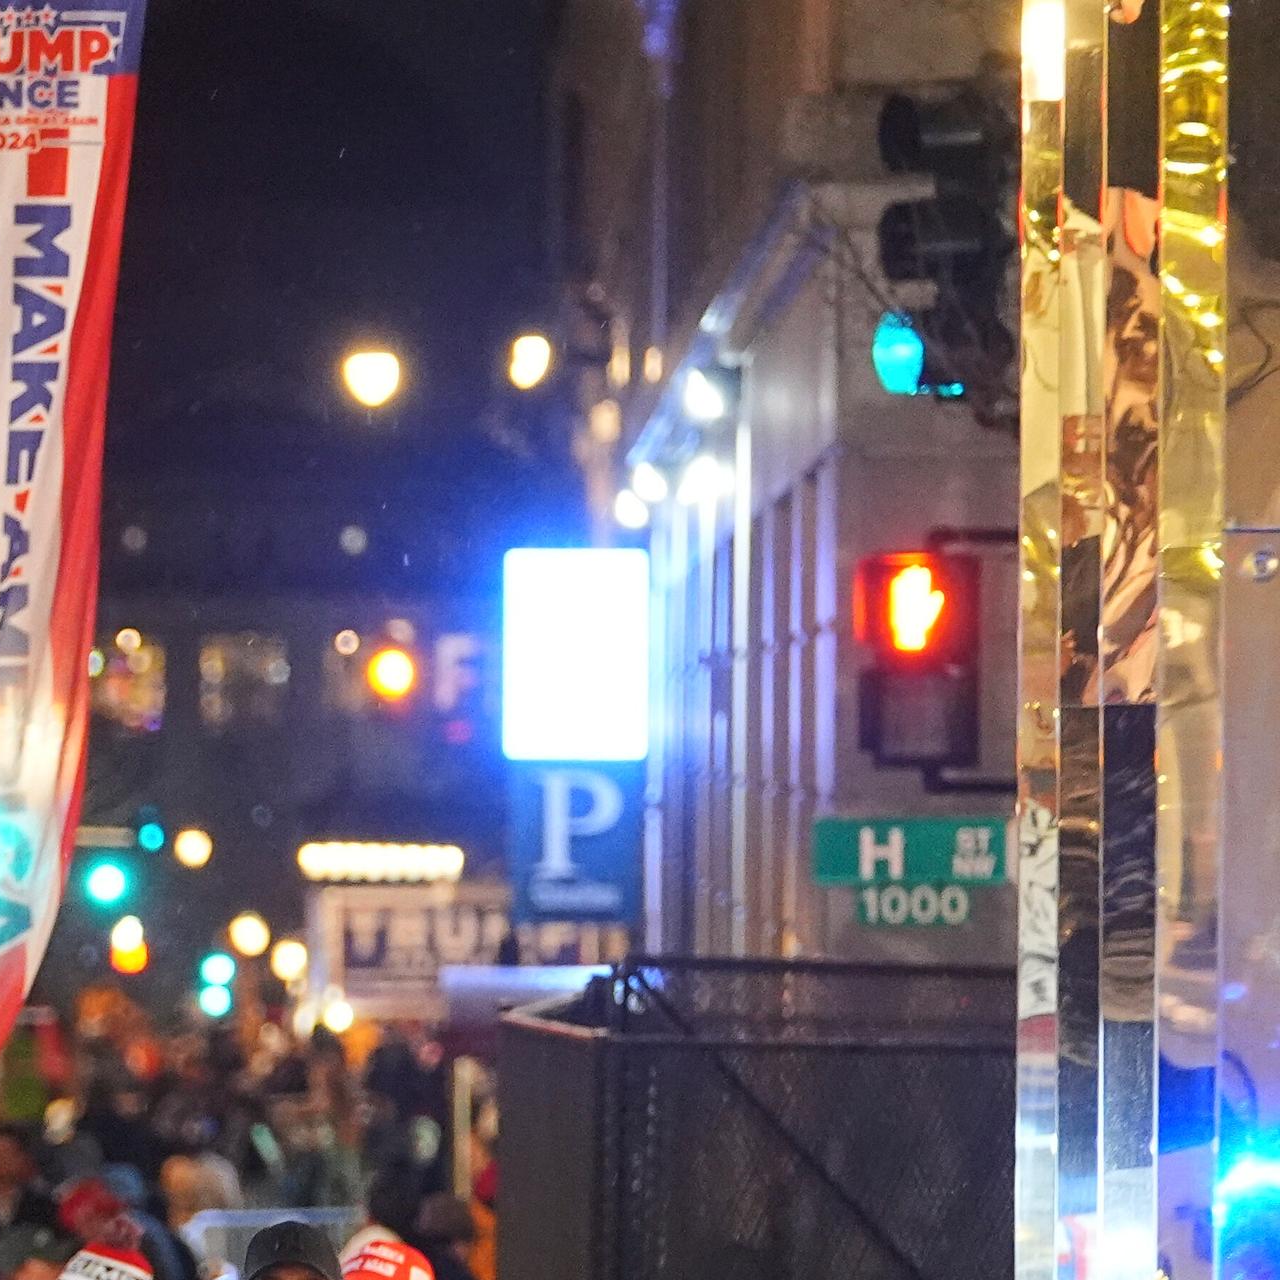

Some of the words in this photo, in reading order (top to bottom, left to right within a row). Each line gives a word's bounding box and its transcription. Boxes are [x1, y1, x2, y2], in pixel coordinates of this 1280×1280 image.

[5, 203, 73, 485] MAKE
[532, 768, 625, 879] P
[858, 825, 905, 882] H
[862, 883, 970, 925] 1000
